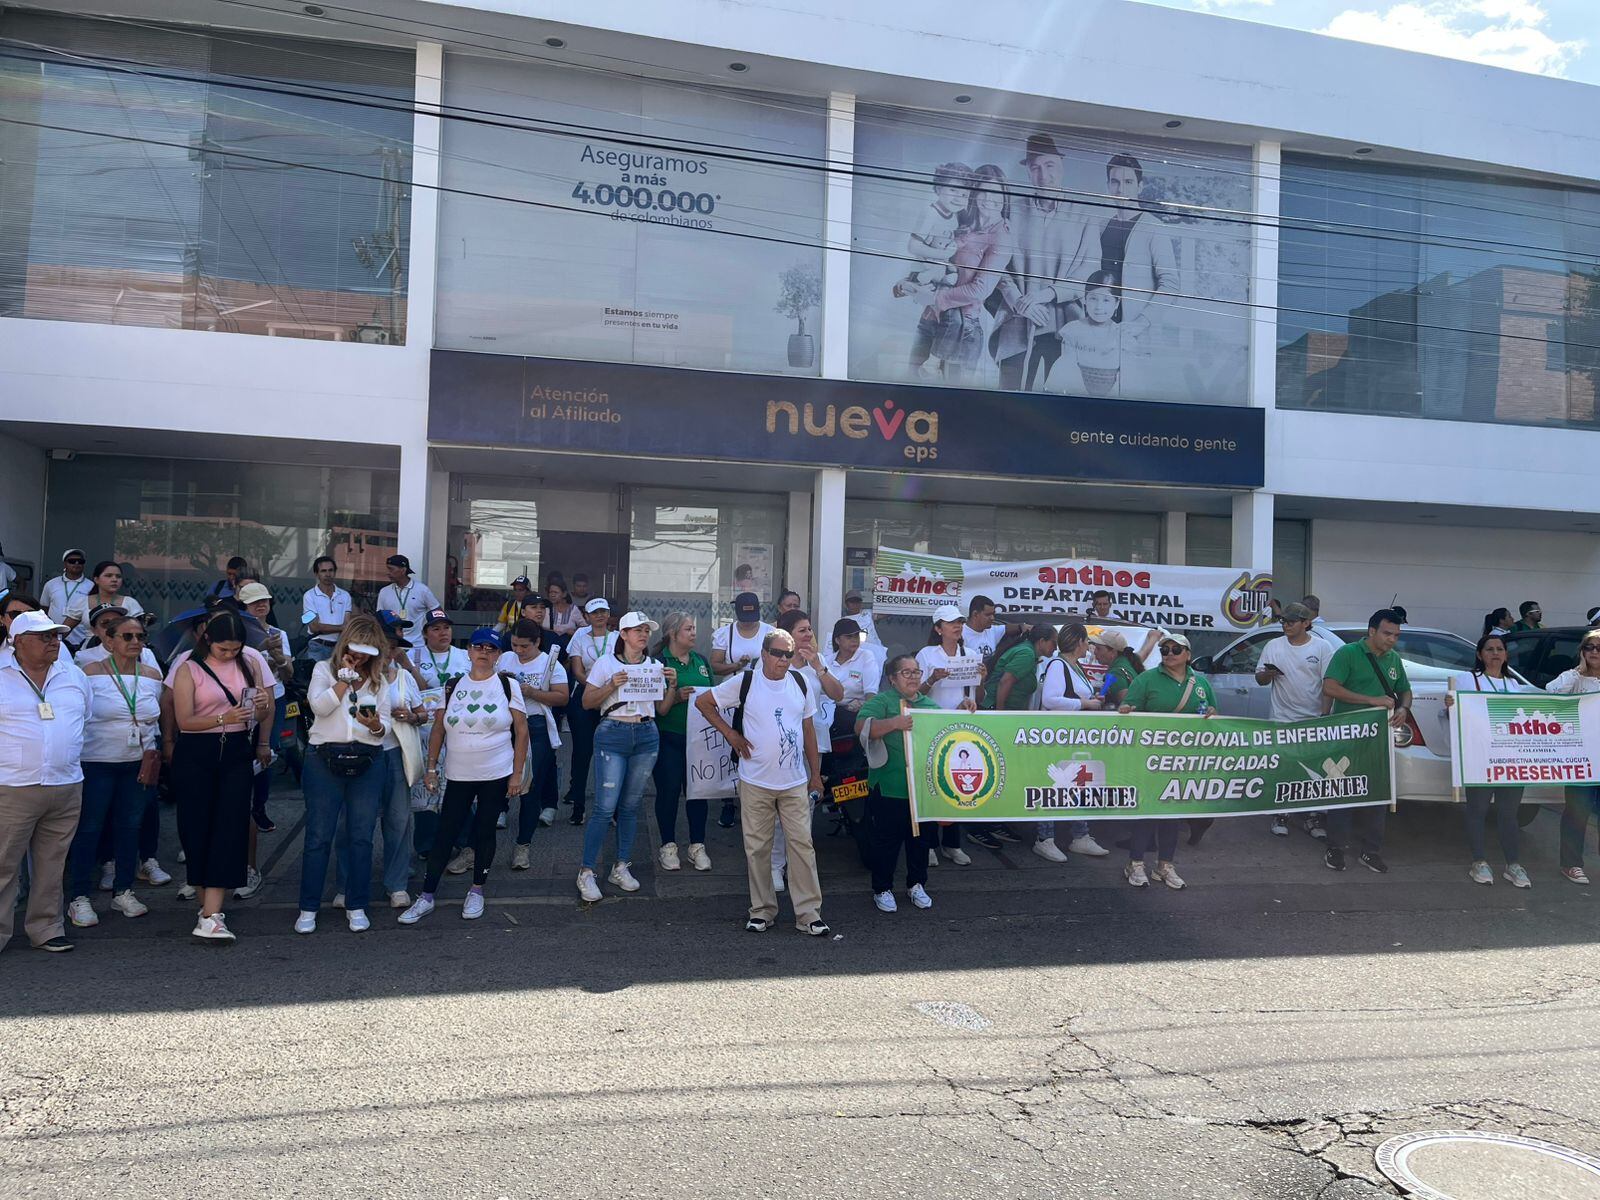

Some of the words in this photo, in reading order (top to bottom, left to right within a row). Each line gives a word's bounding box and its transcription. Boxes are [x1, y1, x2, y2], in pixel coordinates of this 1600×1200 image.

[581, 145, 708, 175] Aseguramos
[621, 173, 630, 183] a
[634, 173, 667, 186] más
[611, 209, 627, 222] de
[630, 211, 713, 229] colombianos
[604, 307, 643, 317] Estamos
[644, 311, 679, 320] siempre
[604, 319, 640, 327] presentes
[662, 322, 679, 330] vida
[531, 384, 609, 404] Atención
[530, 404, 546, 418] al
[552, 405, 621, 424] Afiliado
[766, 400, 938, 444] nueva
[1070, 431, 1114, 444] gente
[1119, 433, 1190, 448] cuidando
[1194, 438, 1237, 451] gente
[903, 445, 938, 463] eps
[875, 575, 960, 597] anthoc
[1038, 565, 1151, 588] anthoc
[875, 595, 926, 605] SECCIONAL
[1086, 608, 1213, 627] SNTANDER
[1014, 726, 1134, 746] ASOCIACIÓN
[1140, 730, 1249, 747] SECCIONAL
[1252, 731, 1273, 746] DE
[1276, 723, 1379, 745] ENFERMERAS
[1496, 719, 1575, 735] anthoc
[691, 760, 715, 783] NO
[1146, 754, 1280, 771] CERTIFICADAS
[1024, 786, 1138, 809] PRESENTE!
[1159, 777, 1265, 801] ANDEC
[1275, 775, 1369, 803] PRESENTE!
